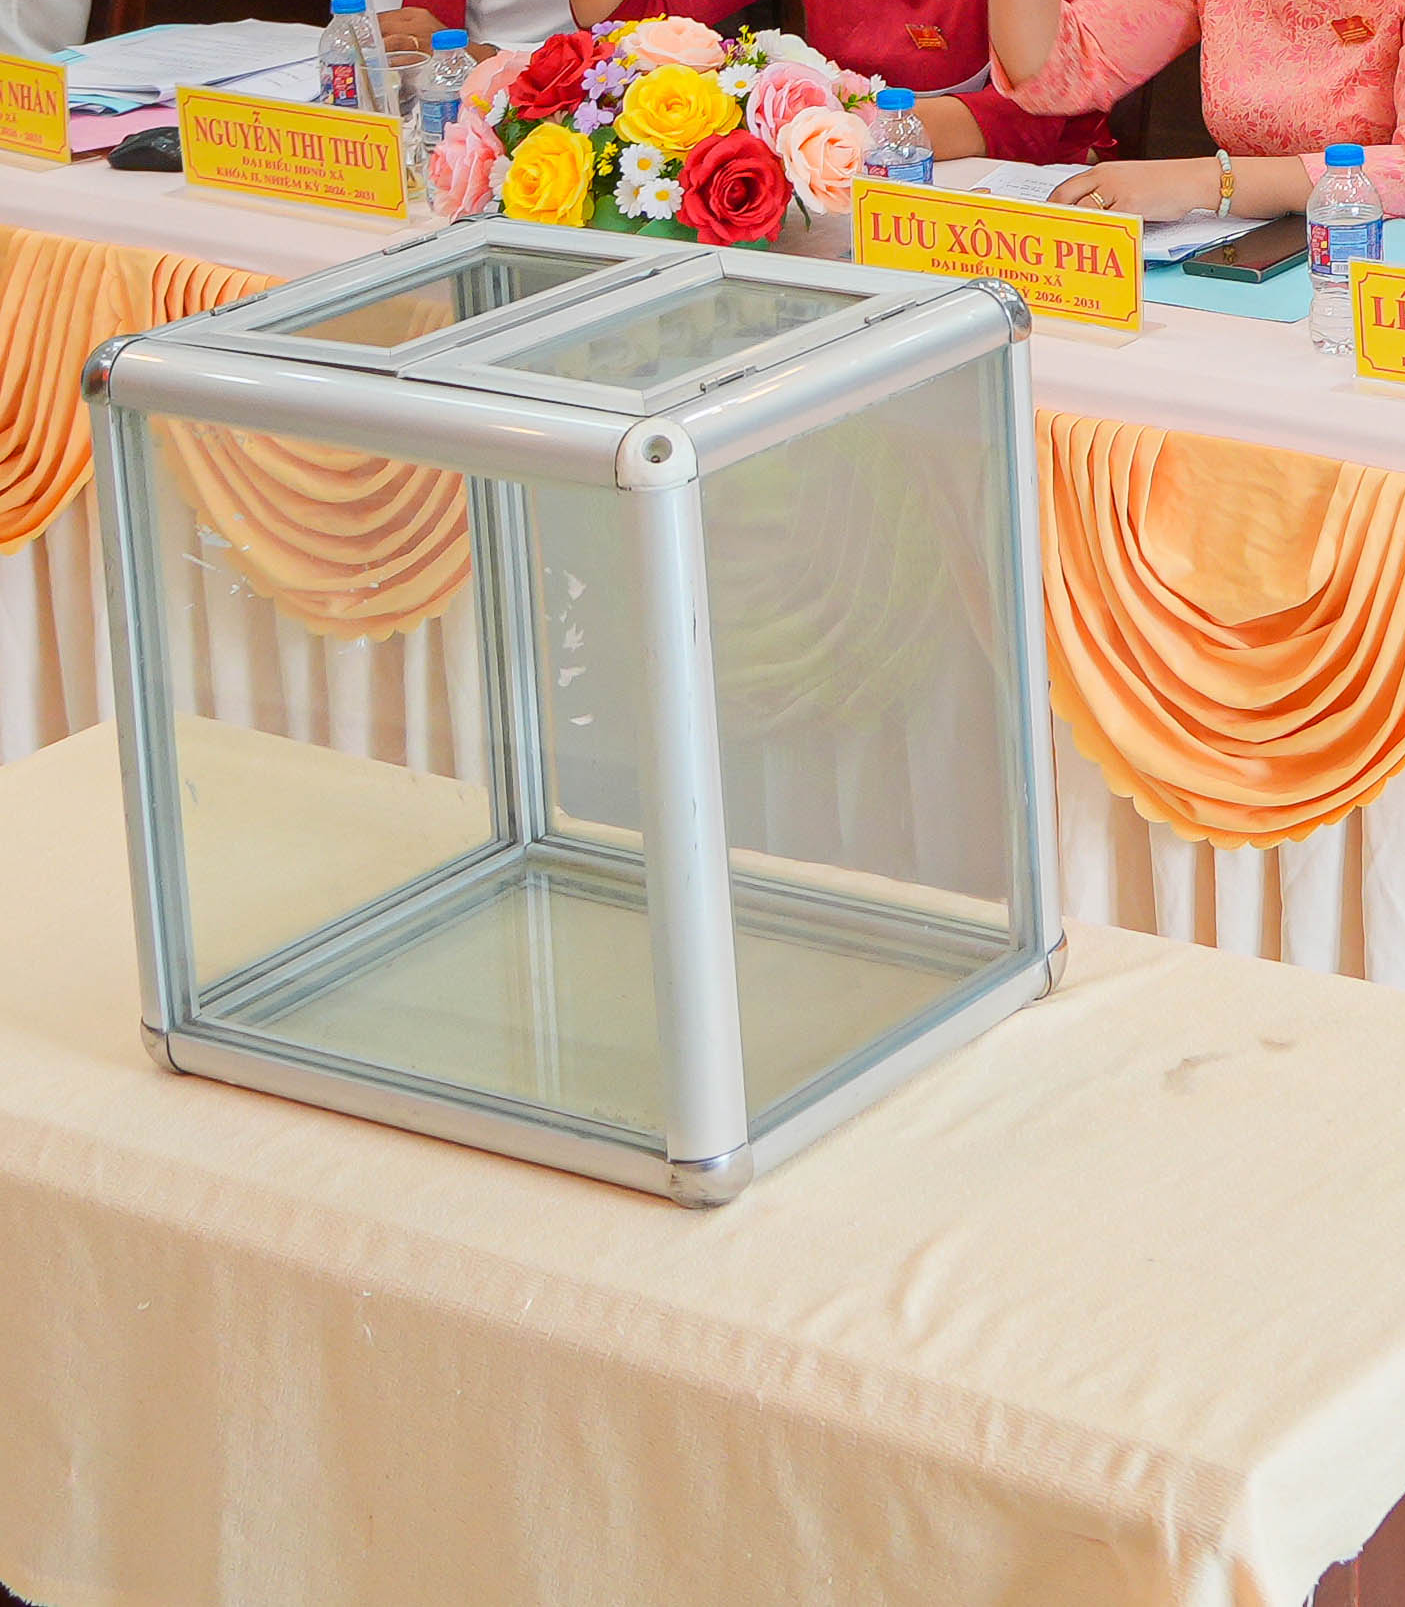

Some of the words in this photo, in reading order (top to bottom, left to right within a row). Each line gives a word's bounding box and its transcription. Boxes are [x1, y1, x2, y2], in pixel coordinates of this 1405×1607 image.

[194, 111, 282, 155] NGUYỄN
[286, 131, 324, 167] THỊ
[329, 134, 389, 171] THÚY
[324, 184, 346, 195] 2026
[871, 212, 936, 249] LƯU
[946, 219, 1043, 266] XÔNG
[1053, 238, 1125, 279] PHA
[931, 258, 956, 272] ĐẠI
[961, 260, 995, 276] BIỂU
[1043, 273, 1062, 287] XÃ
[1035, 291, 1062, 304] 2026
[1073, 296, 1101, 310] 2031
